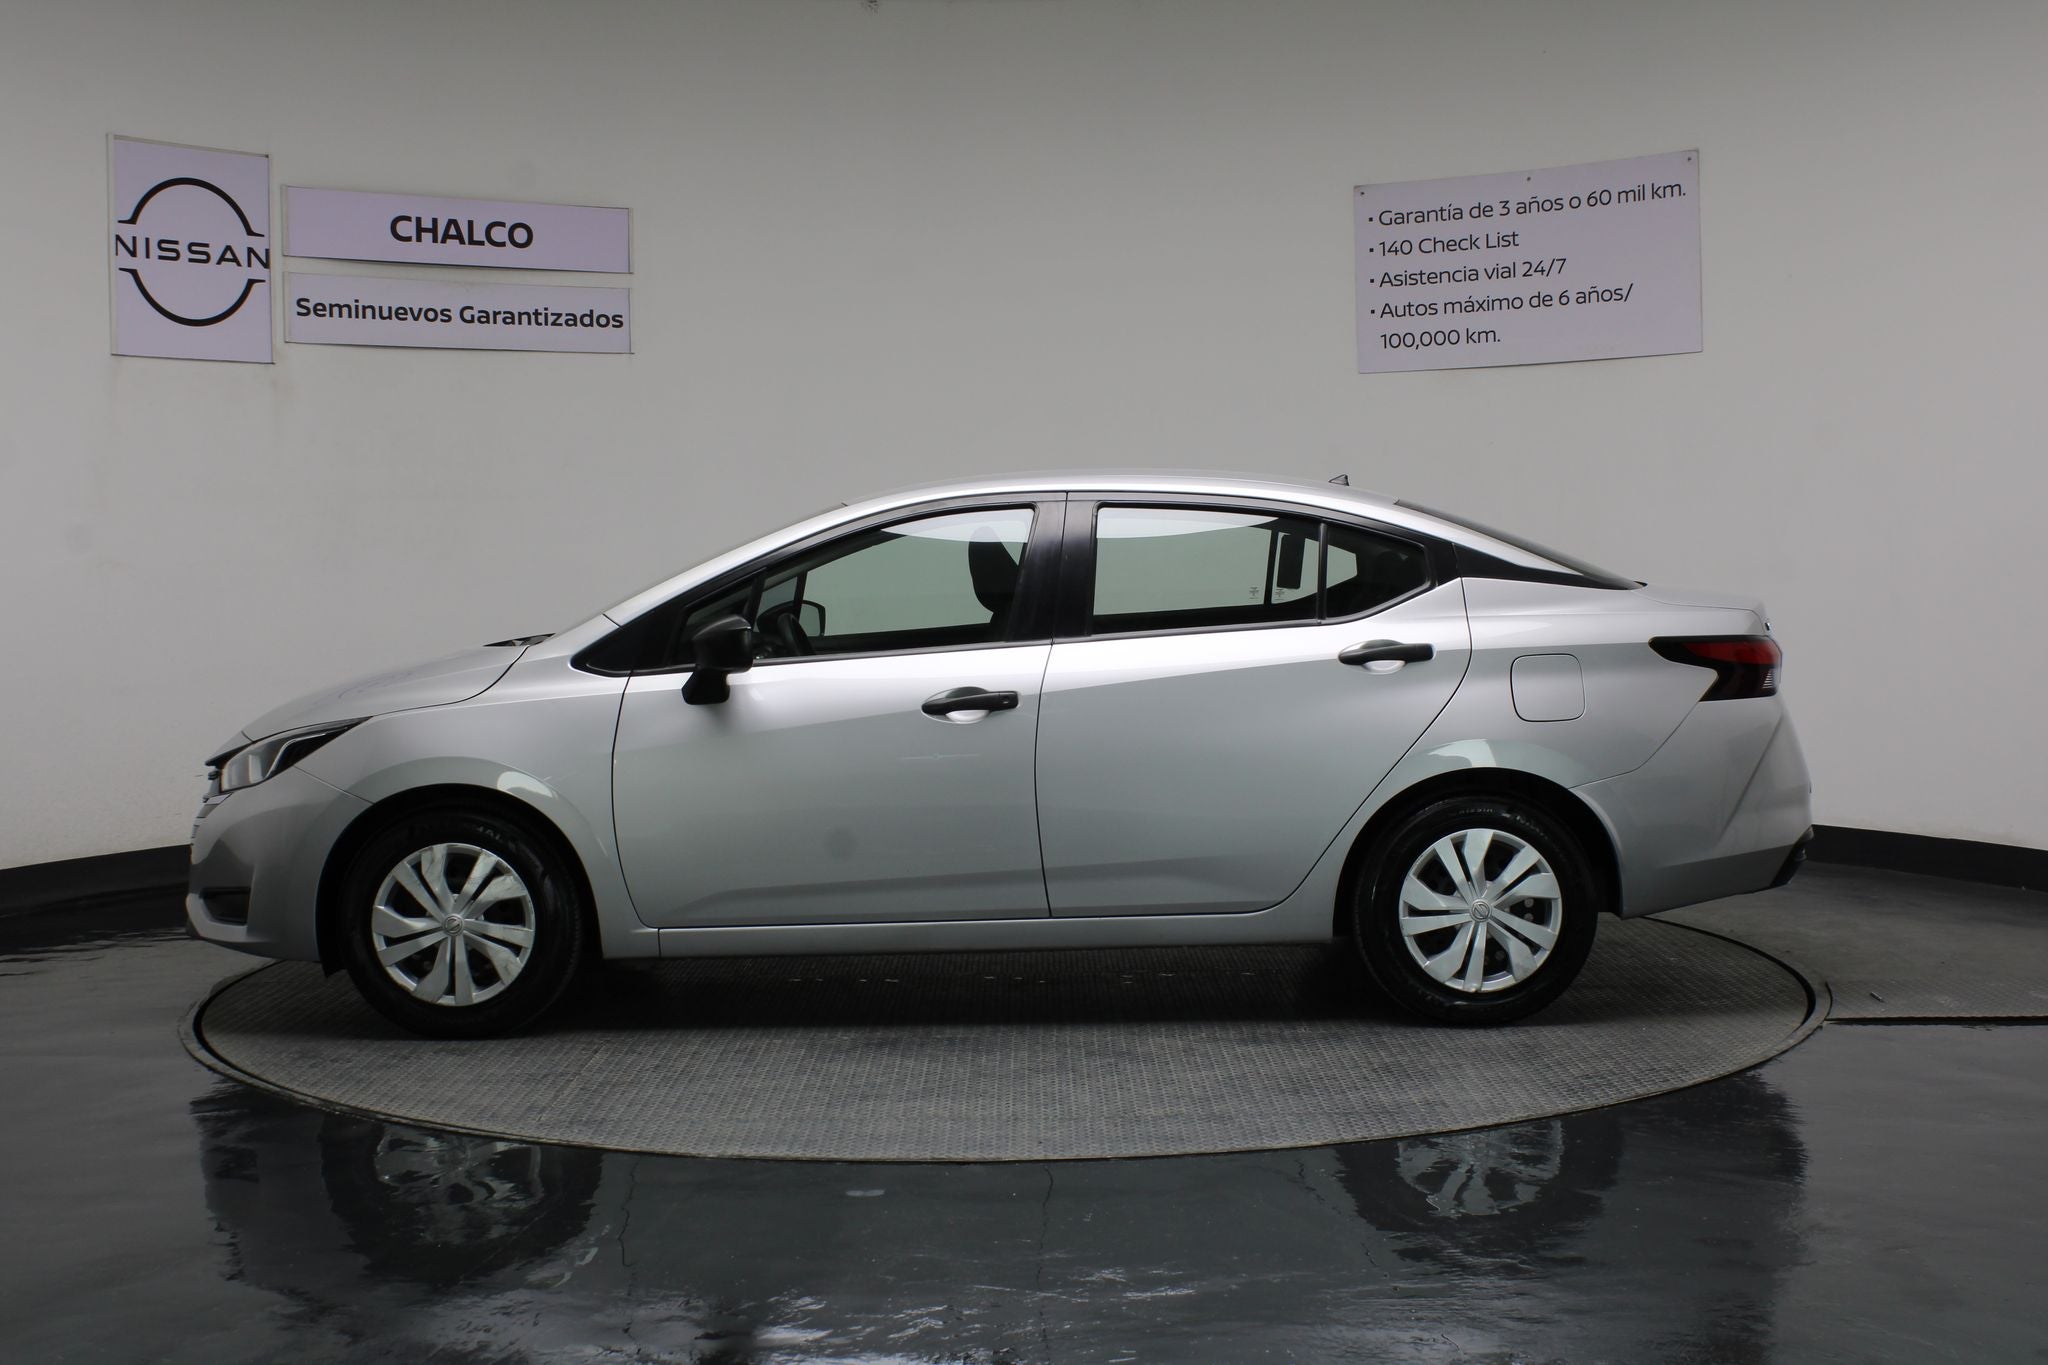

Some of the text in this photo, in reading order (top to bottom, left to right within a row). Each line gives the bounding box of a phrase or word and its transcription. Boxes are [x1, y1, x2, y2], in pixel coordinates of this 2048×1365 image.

[1378, 182, 1687, 227] Garantía de 3 años o 60 mil km.
[389, 214, 534, 250] CHALCO
[1378, 230, 1520, 257] 140 Check List
[115, 234, 270, 269] NISSAN
[1379, 257, 1567, 288] Asistencia vial 24/7
[295, 297, 625, 330] Seminuevos Garantizados
[1379, 282, 1634, 319] Autos máximo de 6 años/
[1379, 327, 1502, 351] 100,000 km.
